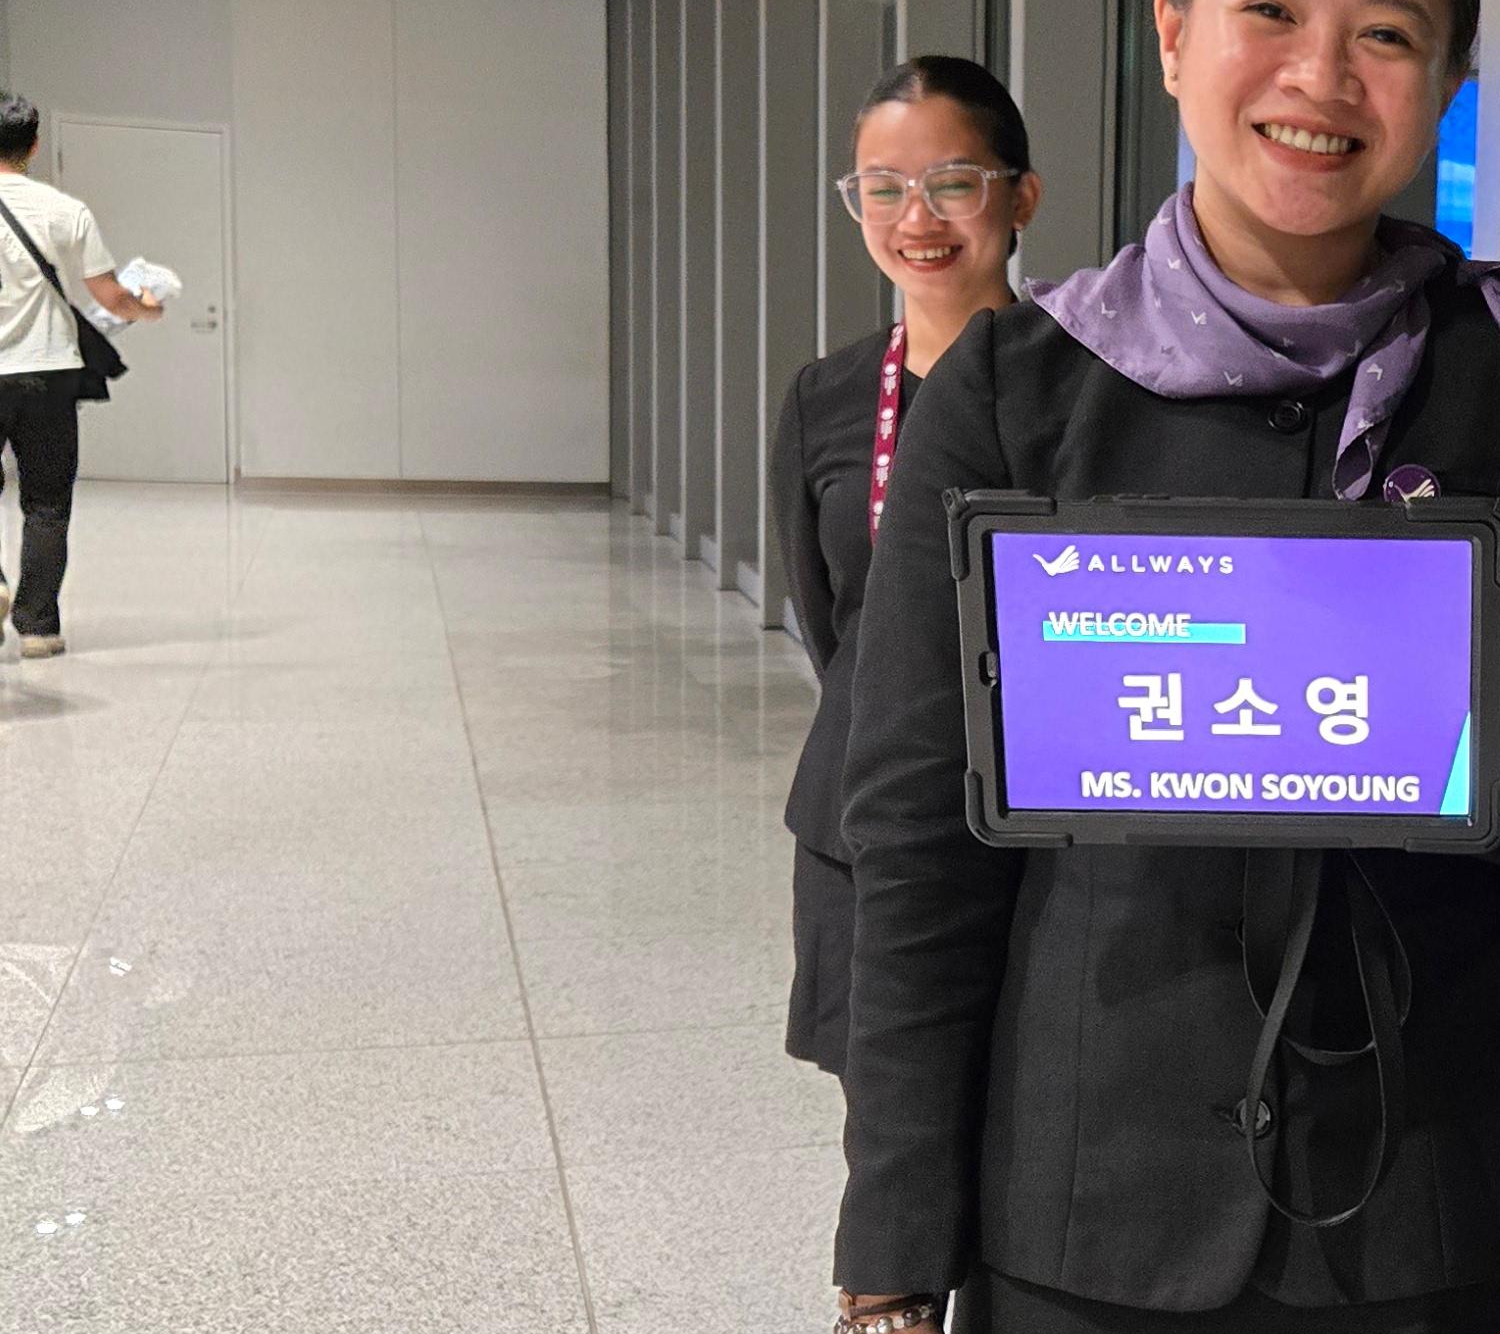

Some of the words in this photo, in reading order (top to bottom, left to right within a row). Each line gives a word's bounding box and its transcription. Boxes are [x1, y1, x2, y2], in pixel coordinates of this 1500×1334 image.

[1086, 554, 1234, 575] ALLWAYS
[1048, 611, 1191, 638] WELCOME
[1080, 770, 1142, 799] MS.
[1150, 771, 1254, 800] KWON
[1261, 773, 1420, 803] SOYOUNG
